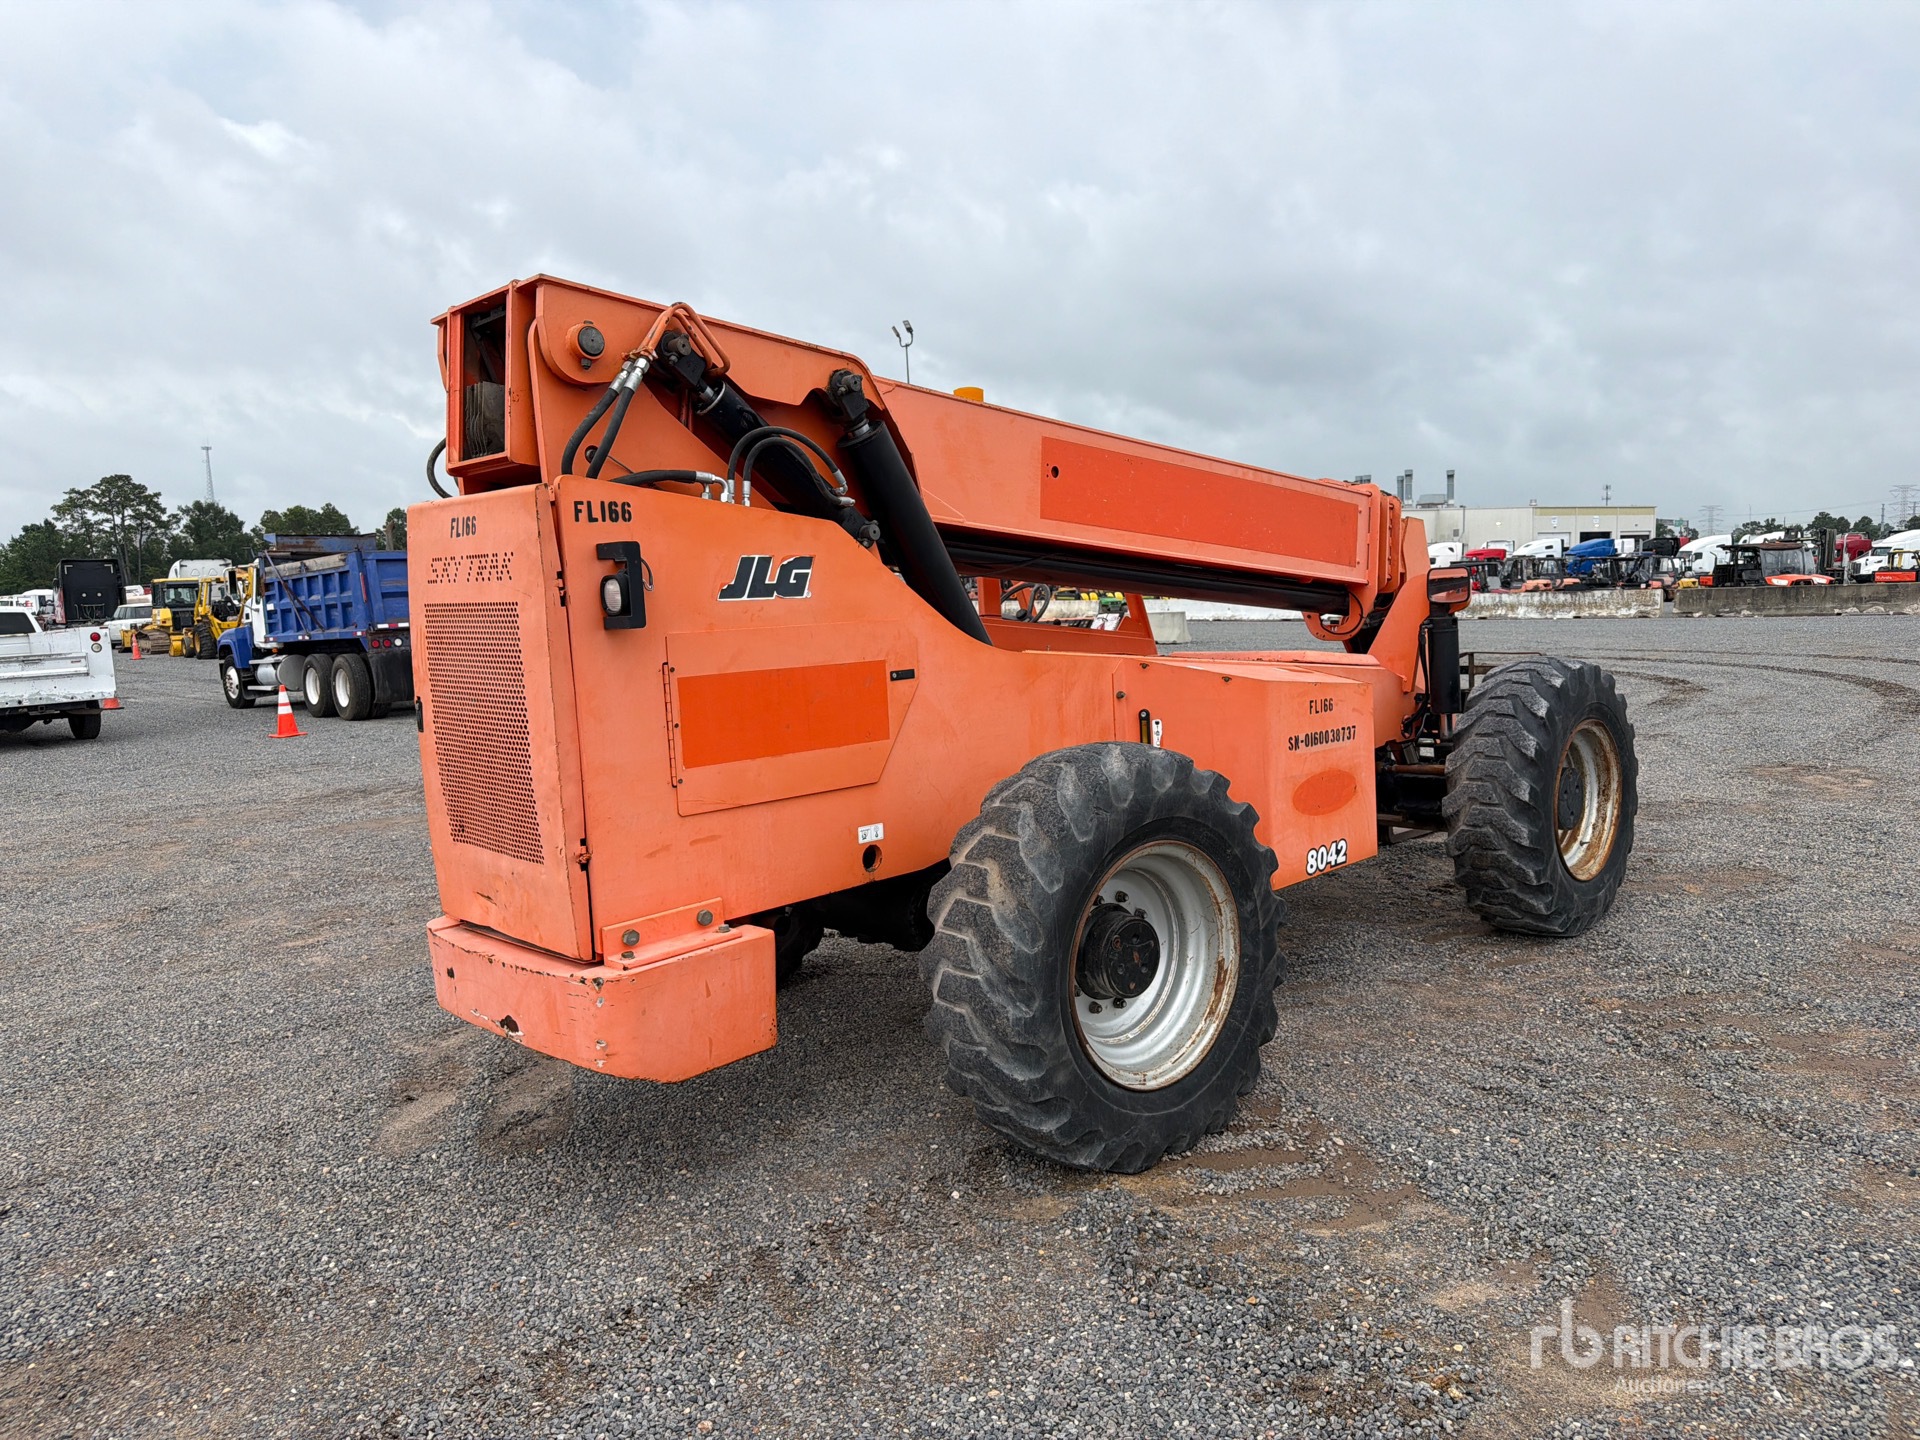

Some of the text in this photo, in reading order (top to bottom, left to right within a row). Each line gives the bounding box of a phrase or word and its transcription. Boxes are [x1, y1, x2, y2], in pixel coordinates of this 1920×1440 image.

[574, 501, 632, 522] FL166
[450, 516, 477, 538] FL166
[717, 554, 813, 601] JLG
[1309, 698, 1334, 714] FL166
[1306, 838, 1347, 875] 8042
